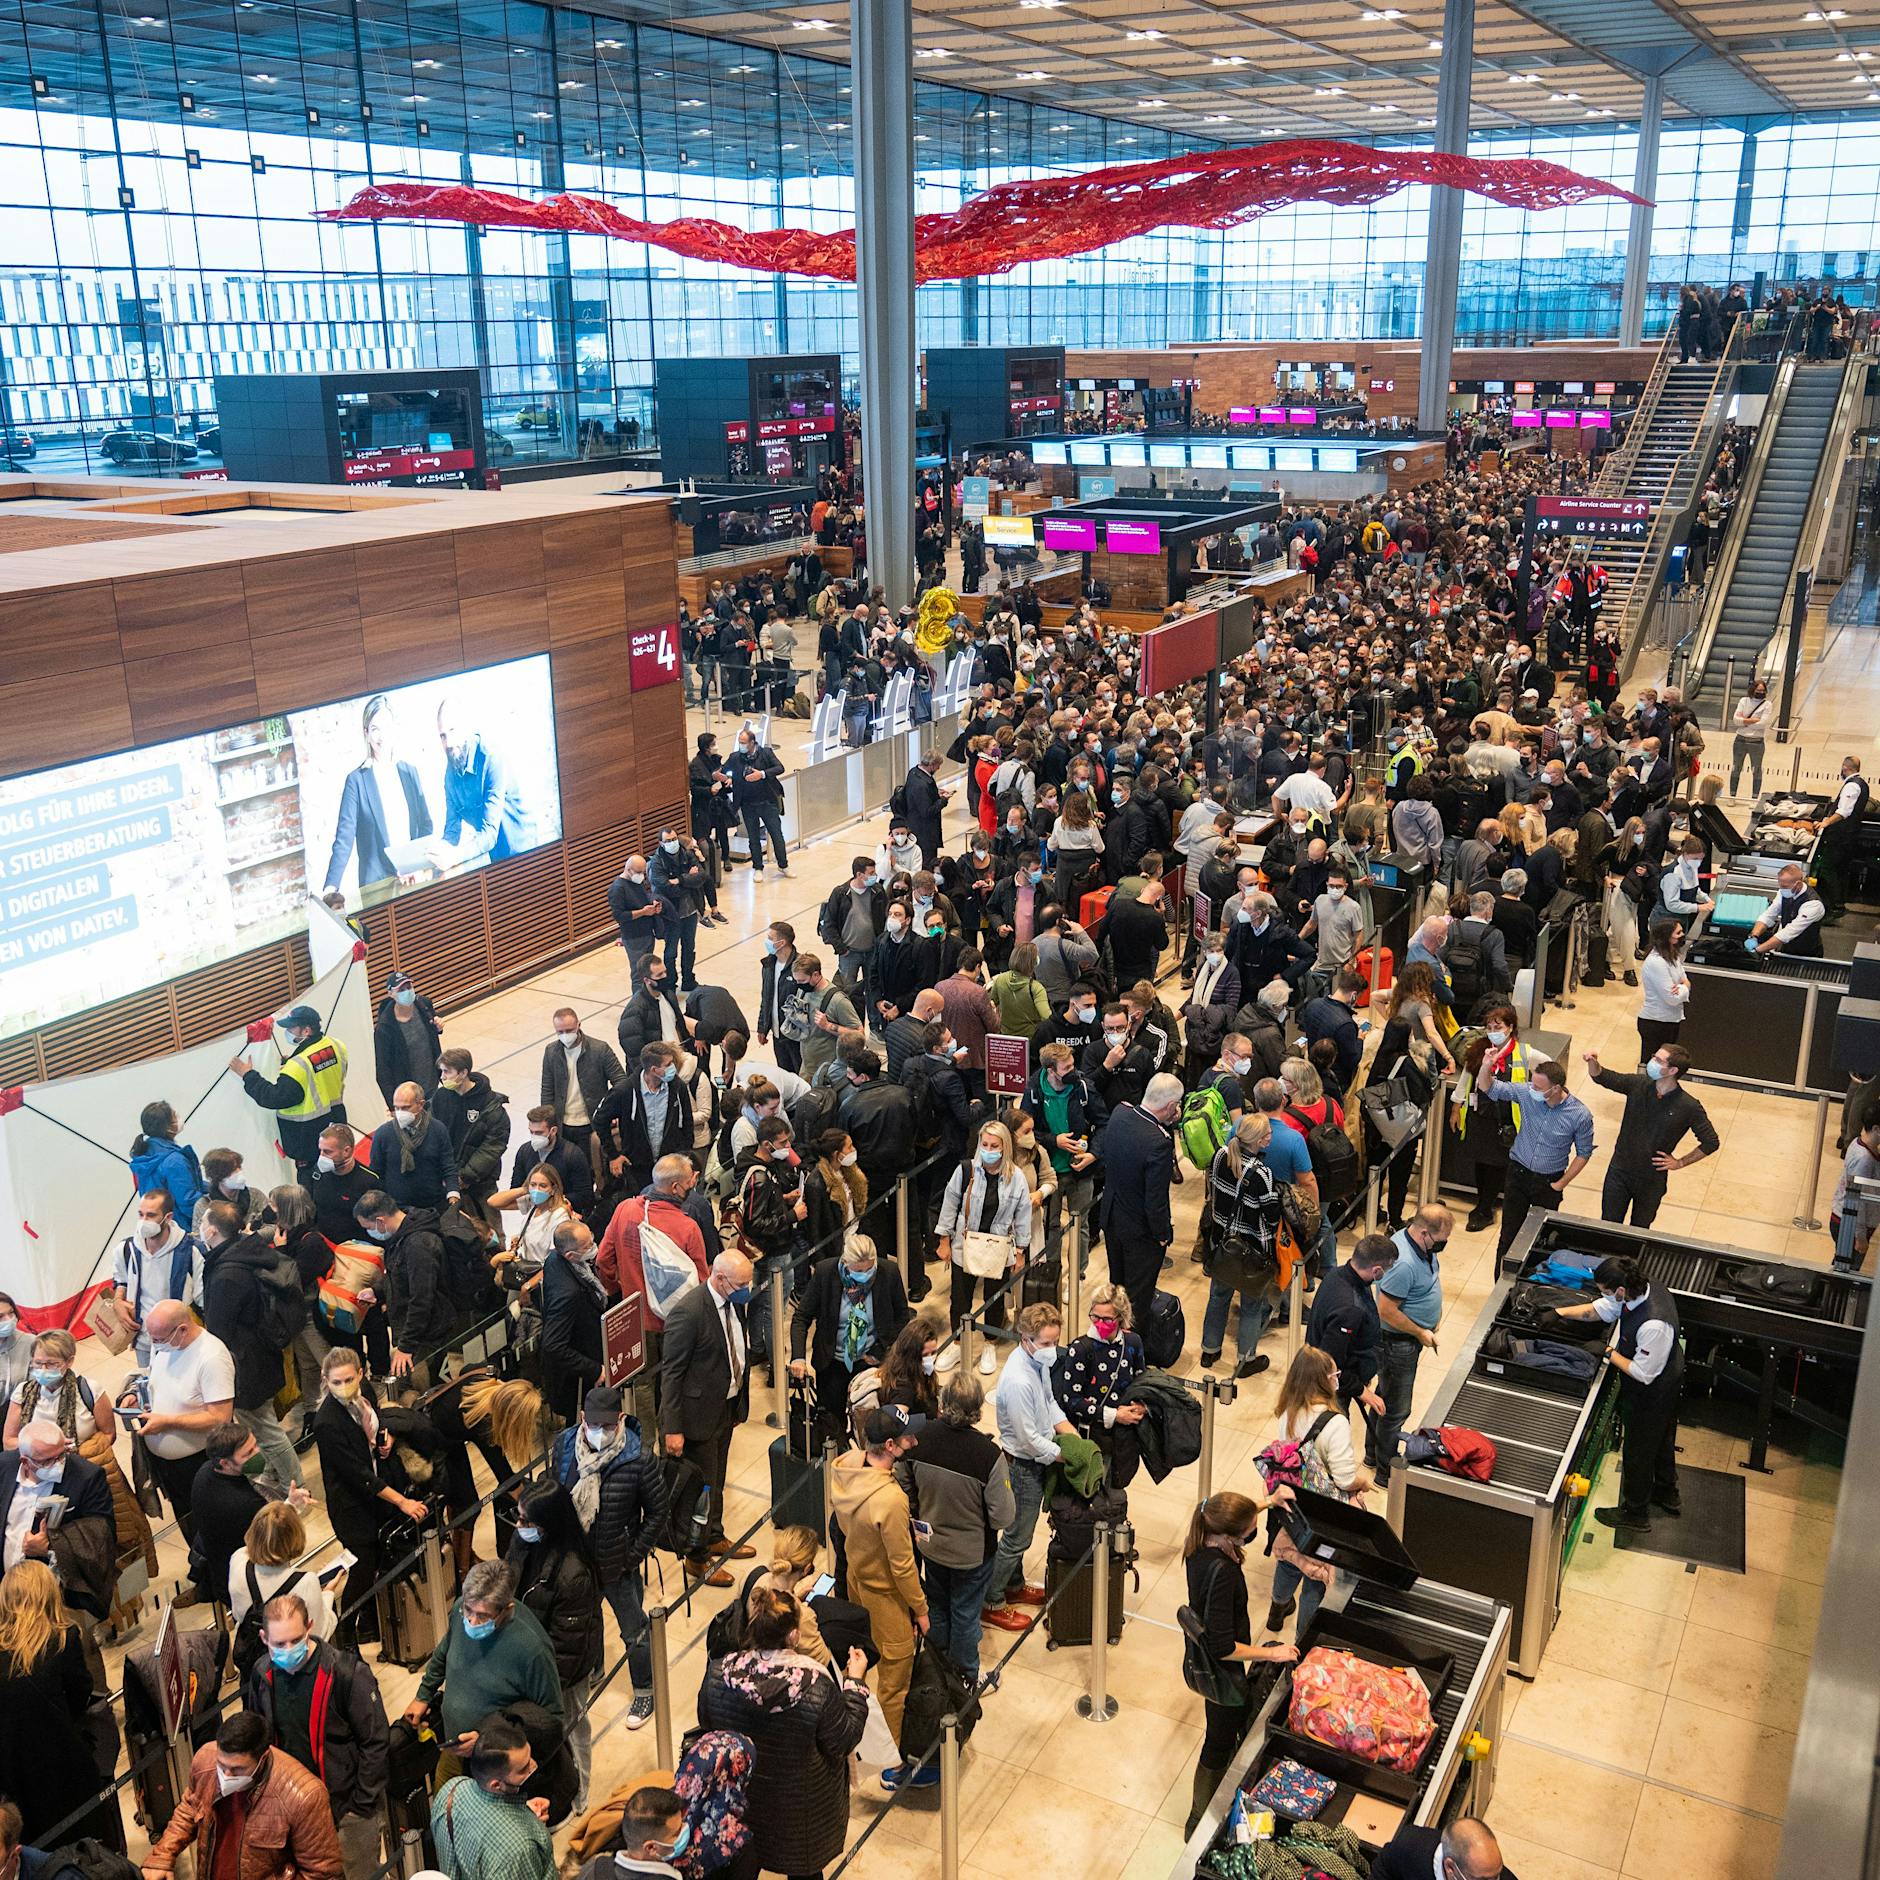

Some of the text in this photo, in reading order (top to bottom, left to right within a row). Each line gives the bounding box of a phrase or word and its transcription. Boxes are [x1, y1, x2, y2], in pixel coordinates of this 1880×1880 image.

[1386, 380, 1394, 392] 6
[1560, 500, 1578, 508] Airline
[1579, 501, 1598, 509] Service
[632, 633, 656, 646] Check-in
[657, 630, 676, 671] 4
[38, 798, 74, 826] FÜR
[77, 788, 118, 817] IHRE
[120, 775, 175, 805] IDEEN.
[11, 816, 161, 876] STEUERBERATUNG
[8, 874, 100, 918] DIGITALEN
[27, 925, 67, 953] VON
[71, 906, 129, 941] DATEV.
[1184, 1380, 1199, 1389] BER
[99, 1783, 117, 1801] BER
